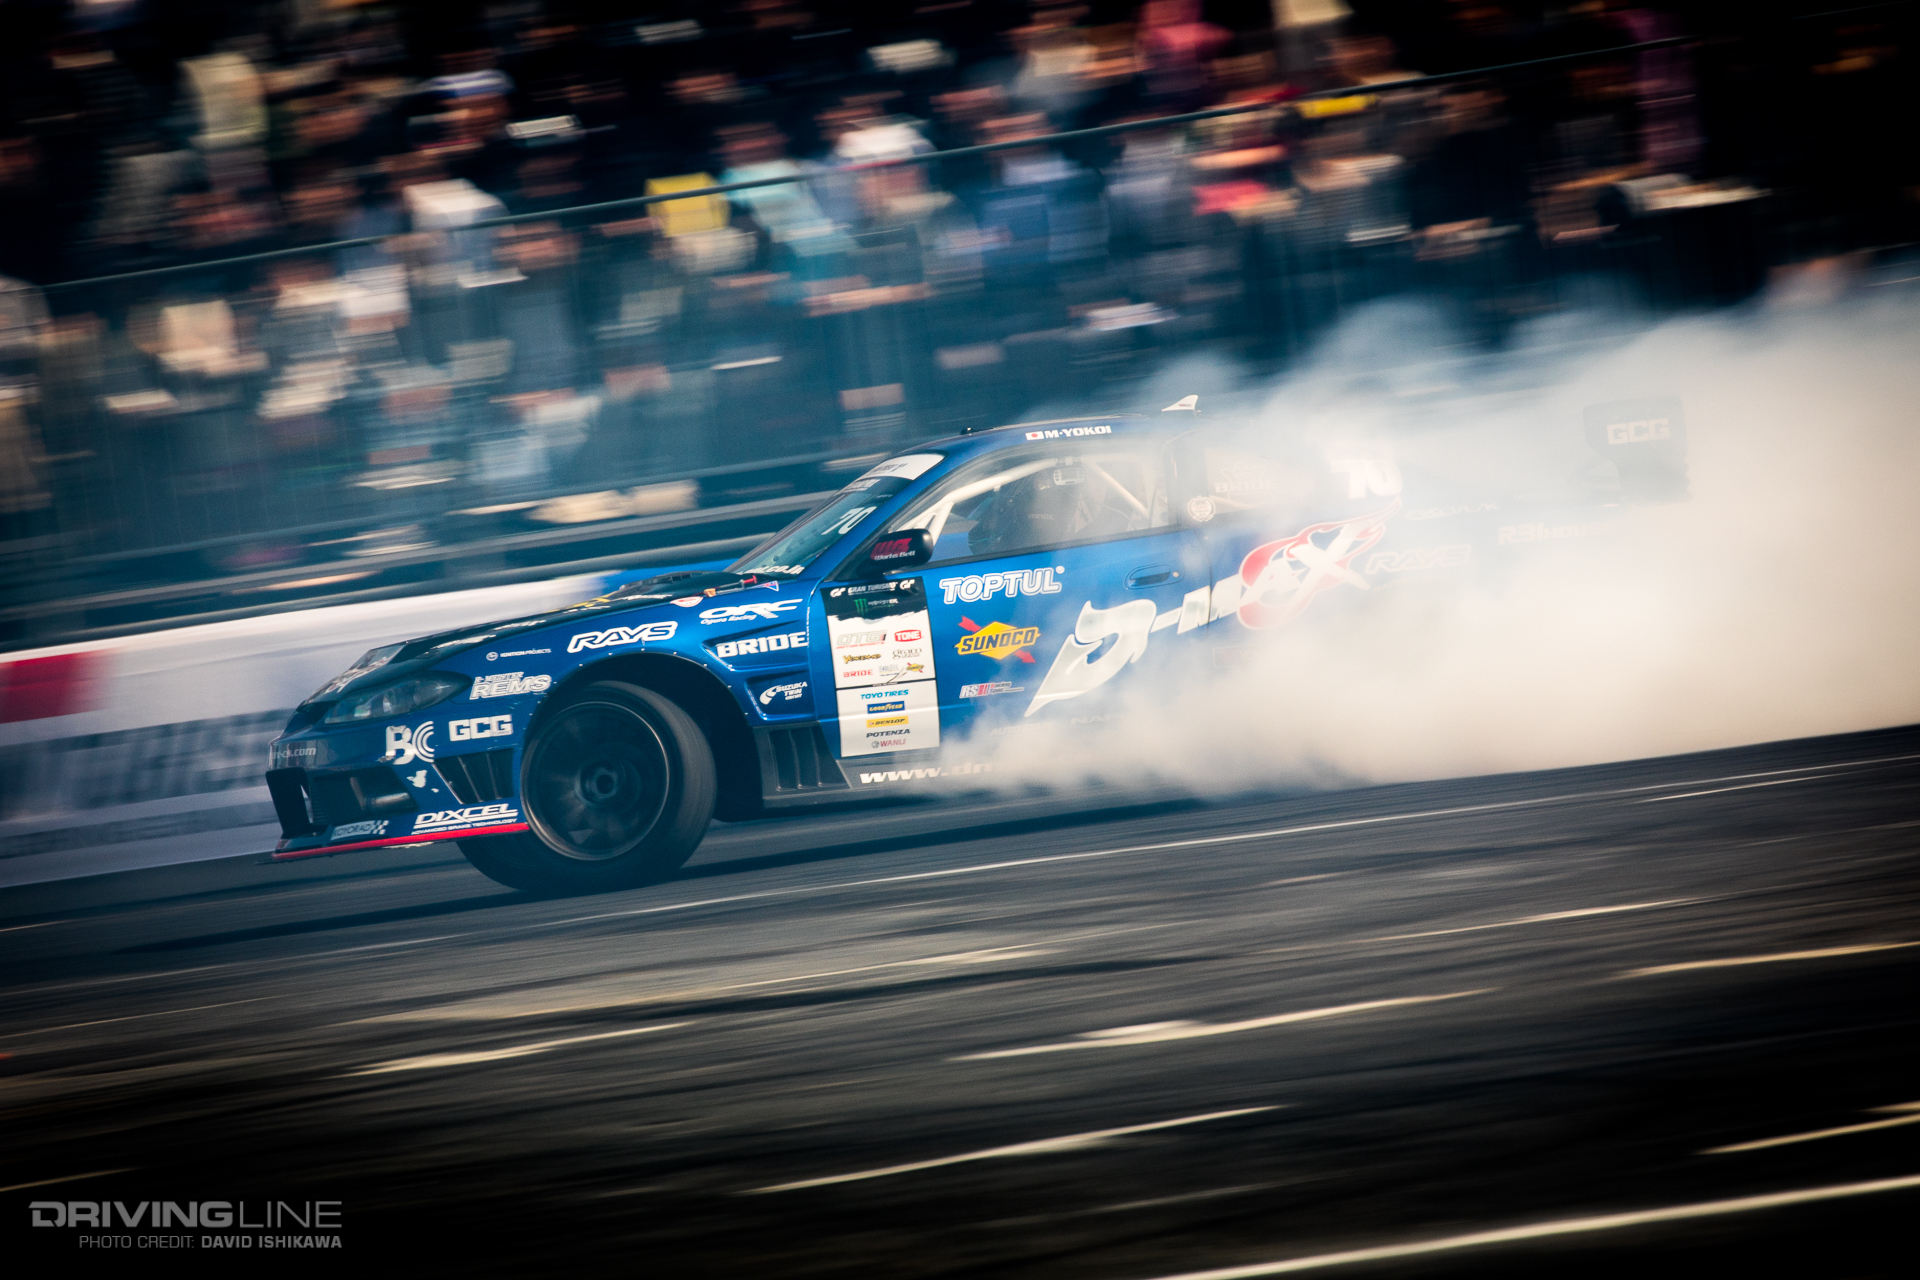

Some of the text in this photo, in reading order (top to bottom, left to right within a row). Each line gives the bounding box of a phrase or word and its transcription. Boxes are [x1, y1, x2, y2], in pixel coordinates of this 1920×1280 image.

[1607, 418, 1671, 445] GCG
[1330, 458, 1402, 500] 70
[821, 506, 877, 535] 70
[1365, 545, 1472, 575] RAYS
[939, 567, 1063, 605] TOPTUL
[699, 599, 803, 620] ORC
[566, 621, 678, 654] RAYS
[717, 631, 809, 659] BRIDE
[895, 630, 921, 641] TONE
[961, 629, 1037, 653] SUNOCO
[776, 681, 808, 692] SUZUKA
[843, 669, 874, 678] BRIDE
[469, 674, 552, 700] REMS
[448, 714, 514, 741] GCG
[866, 729, 911, 738] POTENZA
[880, 739, 906, 747] WANLI
[414, 803, 518, 825] DIXCEL
